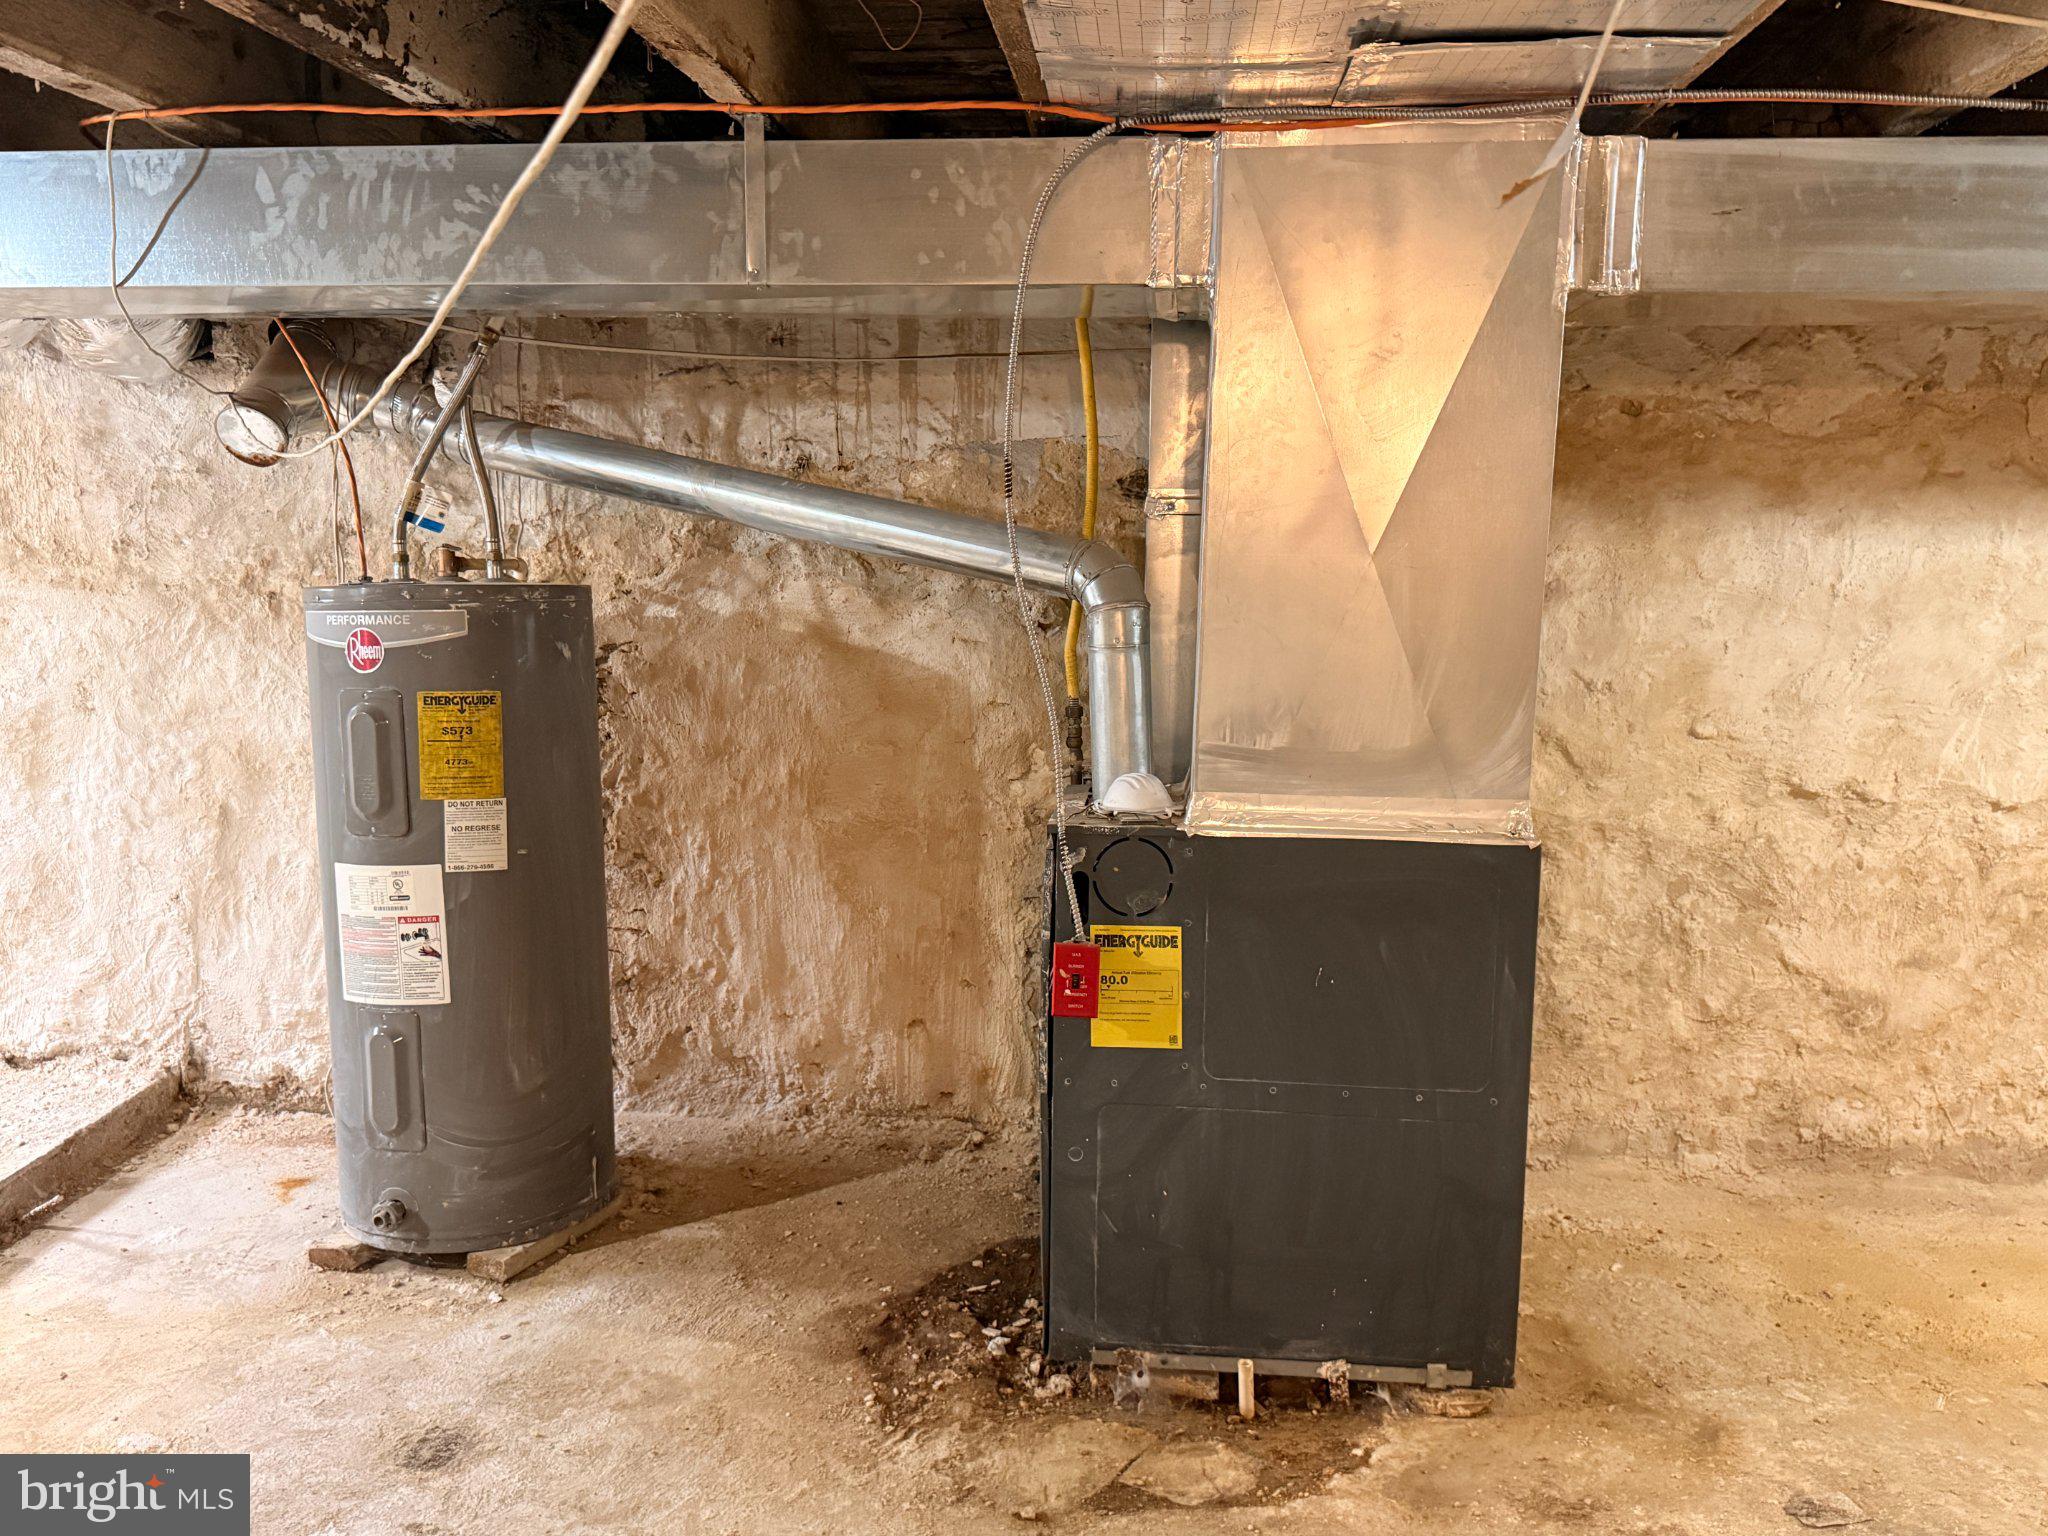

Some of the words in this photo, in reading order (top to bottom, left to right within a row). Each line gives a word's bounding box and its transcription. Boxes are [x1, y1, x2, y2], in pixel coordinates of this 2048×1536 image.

[326, 614, 410, 626] PERFORMANCE
[349, 629, 382, 665] Rheem
[423, 695, 496, 709] ENERGYGUIDE
[442, 726, 473, 736] $573
[444, 758, 468, 766] 4773
[465, 824, 501, 832] REGRESE
[1094, 934, 1178, 951] ENERGYGUIDE
[1100, 975, 1128, 985] 80.0
